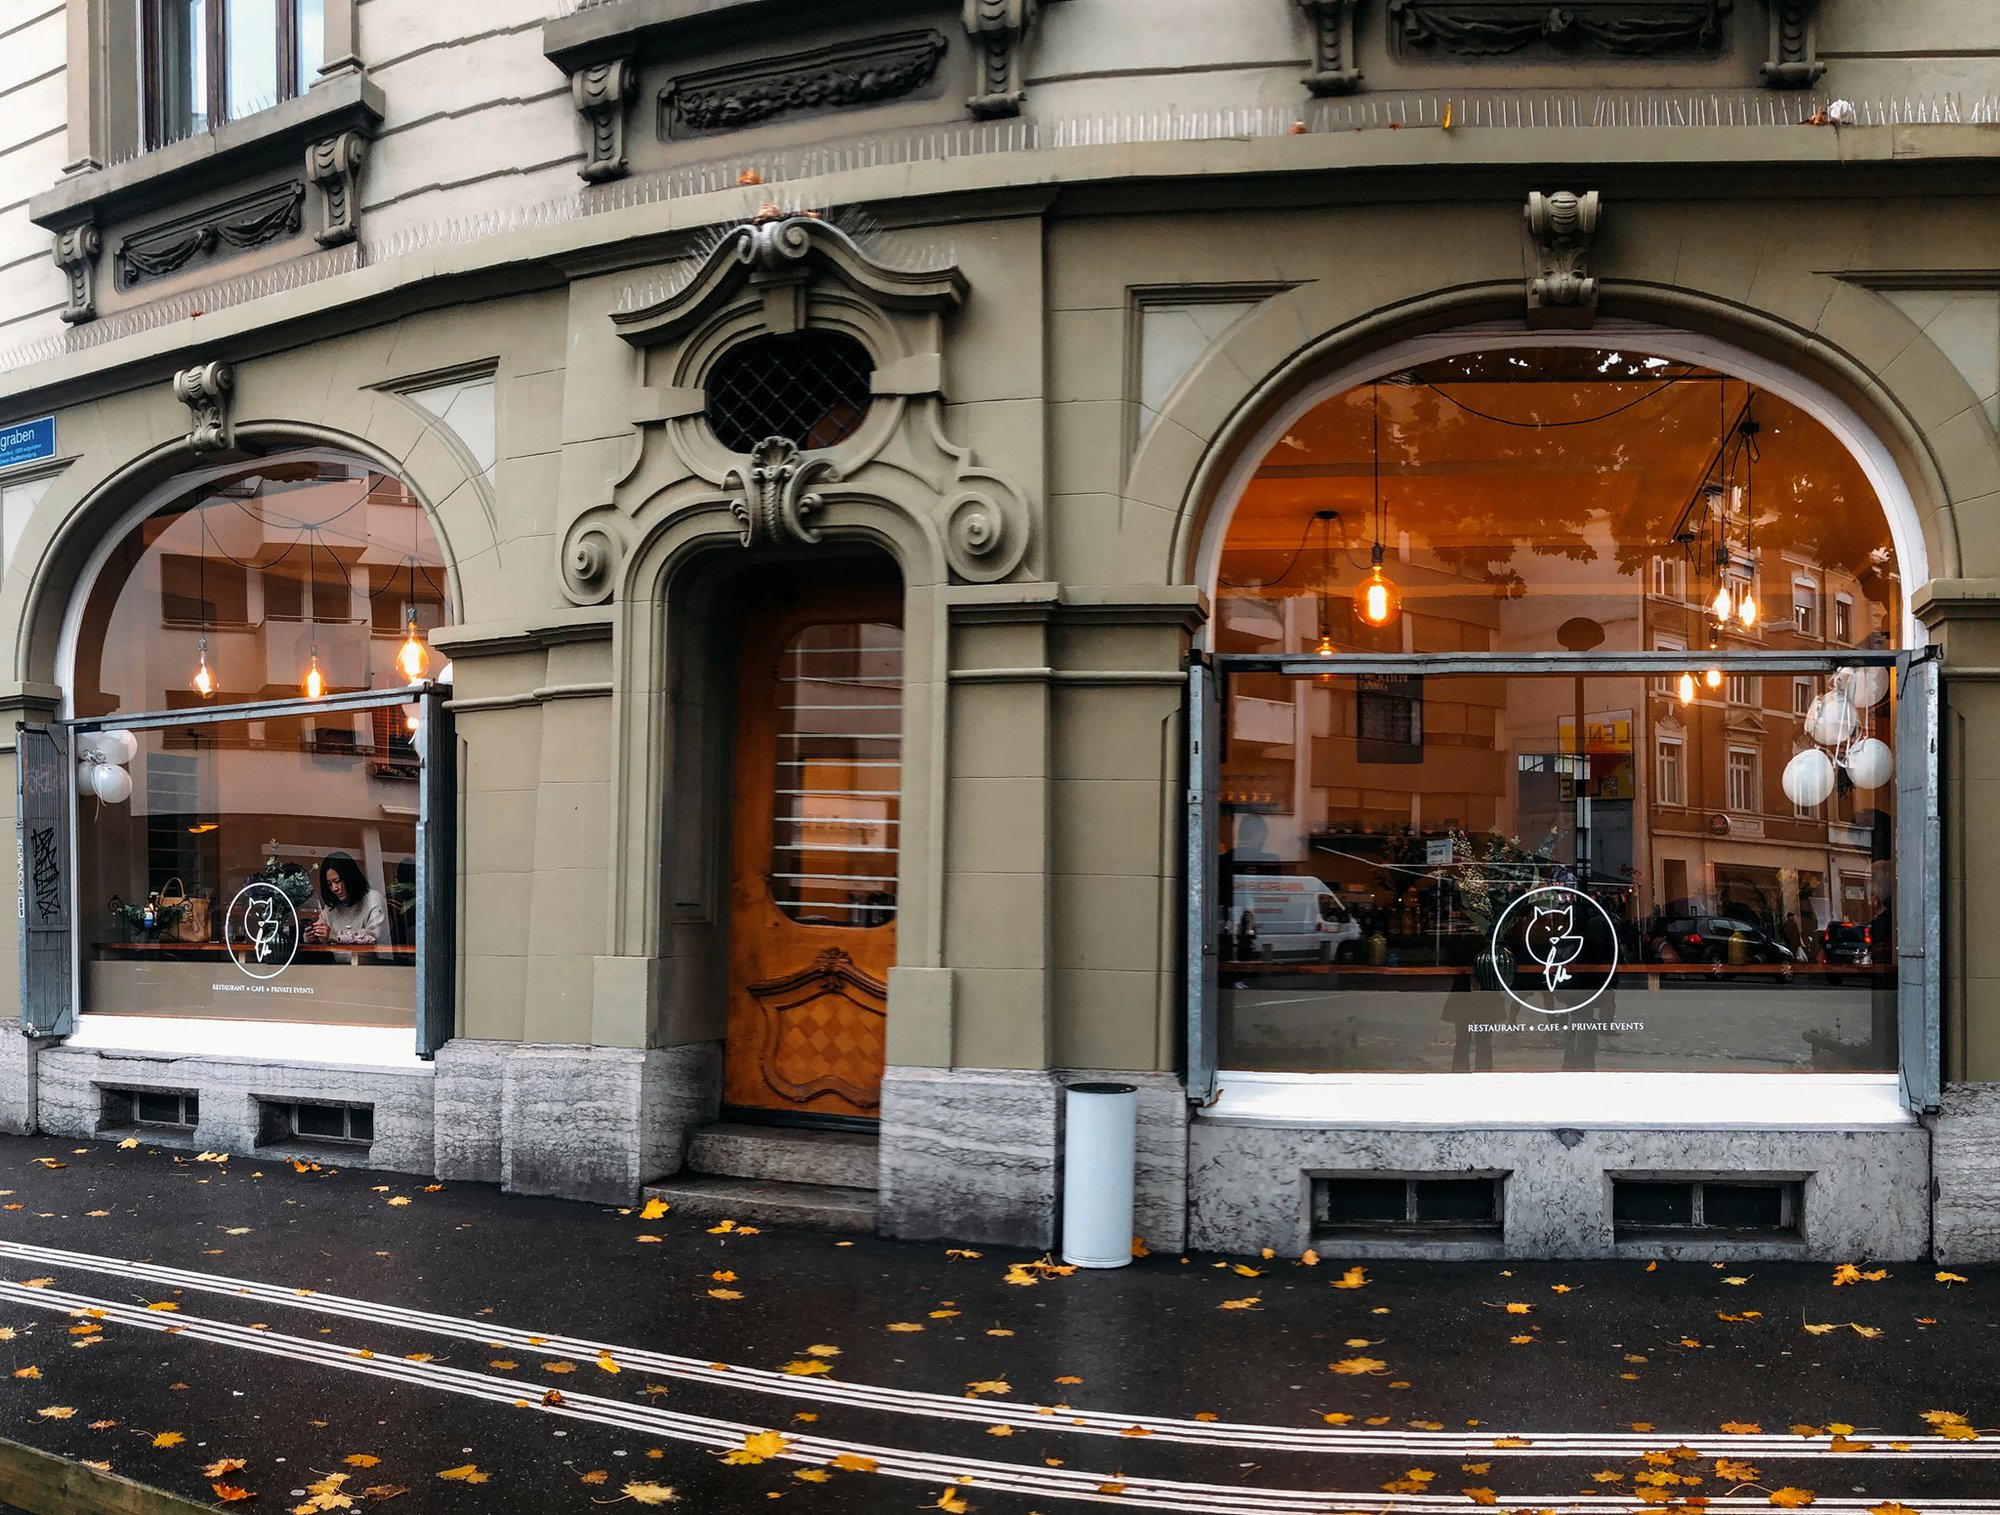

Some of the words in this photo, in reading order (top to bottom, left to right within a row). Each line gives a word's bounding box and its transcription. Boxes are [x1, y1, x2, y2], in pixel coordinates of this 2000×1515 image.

[212, 983, 245, 992] RESTAURANT
[251, 985, 265, 993] CAFE
[271, 986, 293, 994] PRIVATE
[293, 987, 314, 995] EVENTS
[1468, 1023, 1526, 1032] RESTAURANT
[1537, 1023, 1560, 1032] CAFE
[1571, 1022, 1608, 1031] PRIVATE
[1610, 1022, 1645, 1031] EVENTS
